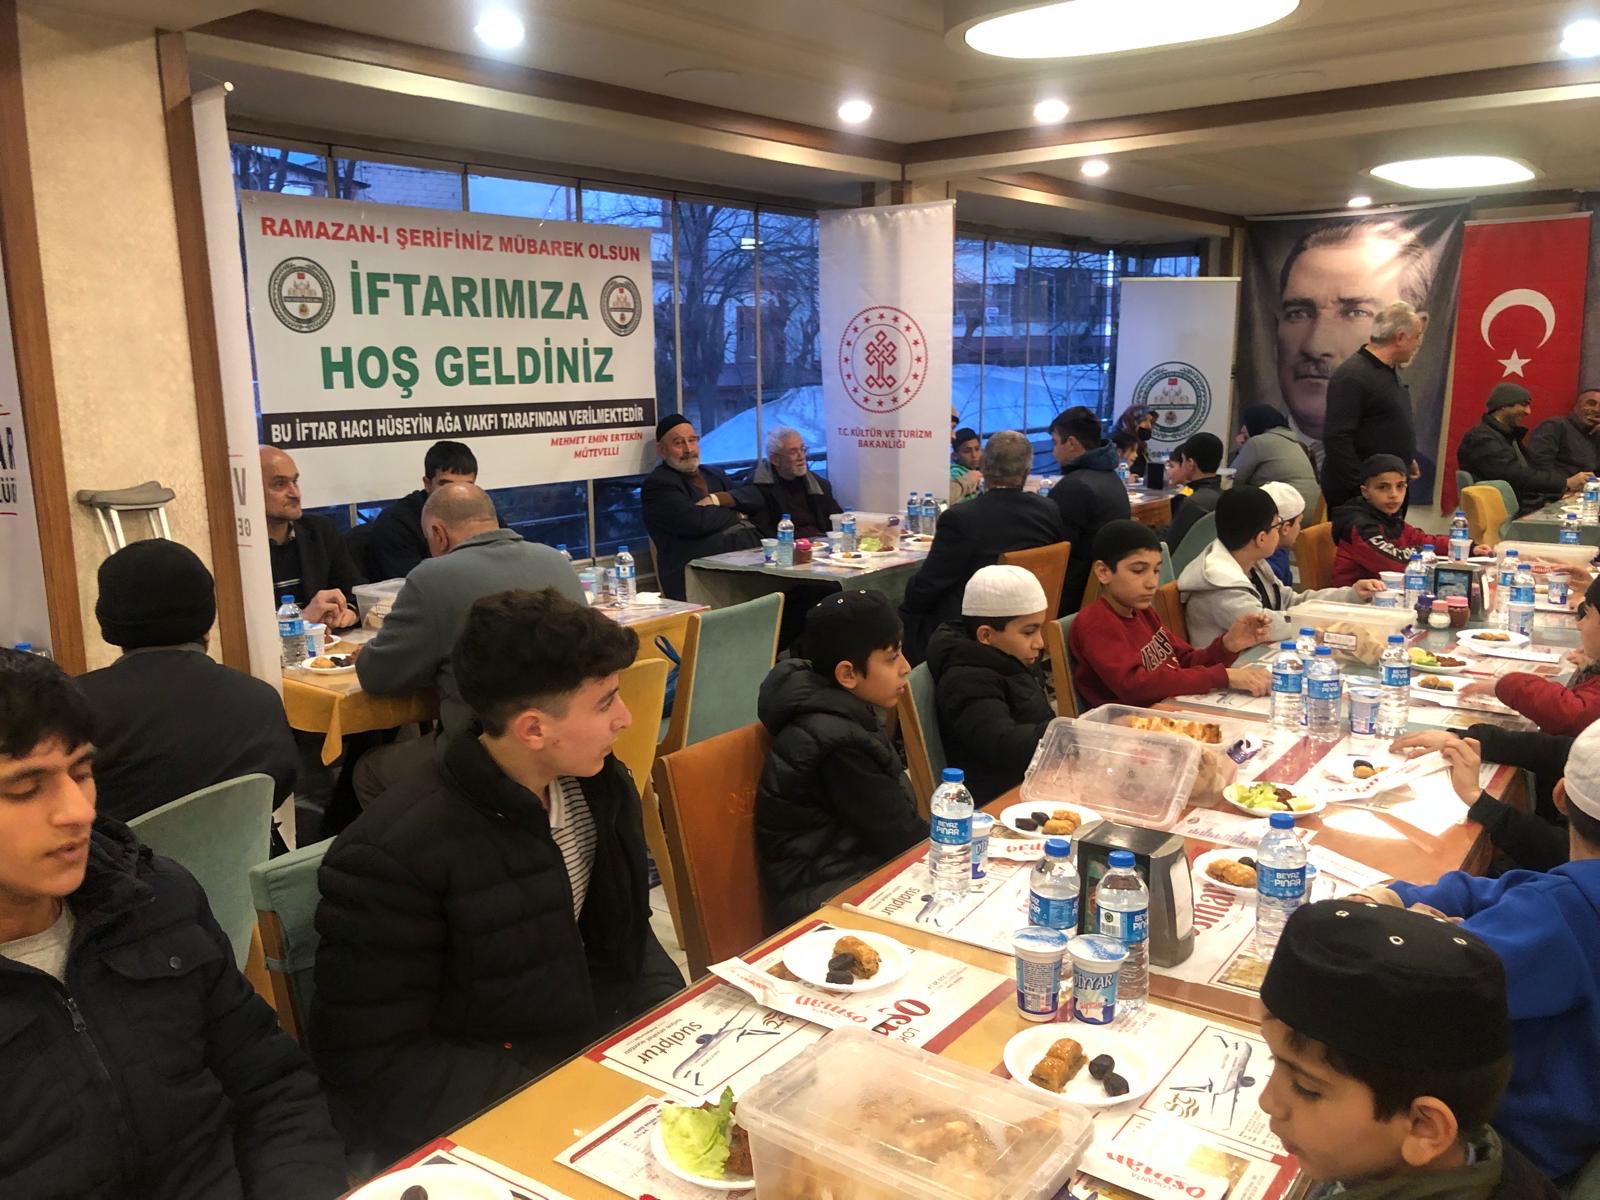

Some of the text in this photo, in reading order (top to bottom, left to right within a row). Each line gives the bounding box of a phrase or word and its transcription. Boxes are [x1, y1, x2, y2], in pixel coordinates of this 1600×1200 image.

[261, 216, 640, 262] RAMAZAN-I ŞERİFİNİZ MÜBAREK OLSUN
[350, 260, 589, 320] İFTARIMIZA
[320, 337, 614, 399] HOŞ GELDİNİZ
[271, 403, 644, 443] BU İFTAR HACI HÜSEYİN AĞA VAKFI TARAFINDAN VERİLMEKTEDİR
[550, 431, 643, 447] MEHMET EMİN ERTEKİN
[851, 426, 882, 437] KÜLTÜR
[884, 429, 896, 438] VE
[897, 427, 933, 439] TURİZM
[574, 446, 620, 459] MÜTEVELLİ
[858, 439, 906, 449] BAKANLIĞI
[881, 886, 921, 916] sualptur
[637, 1021, 703, 1064] sualptur
